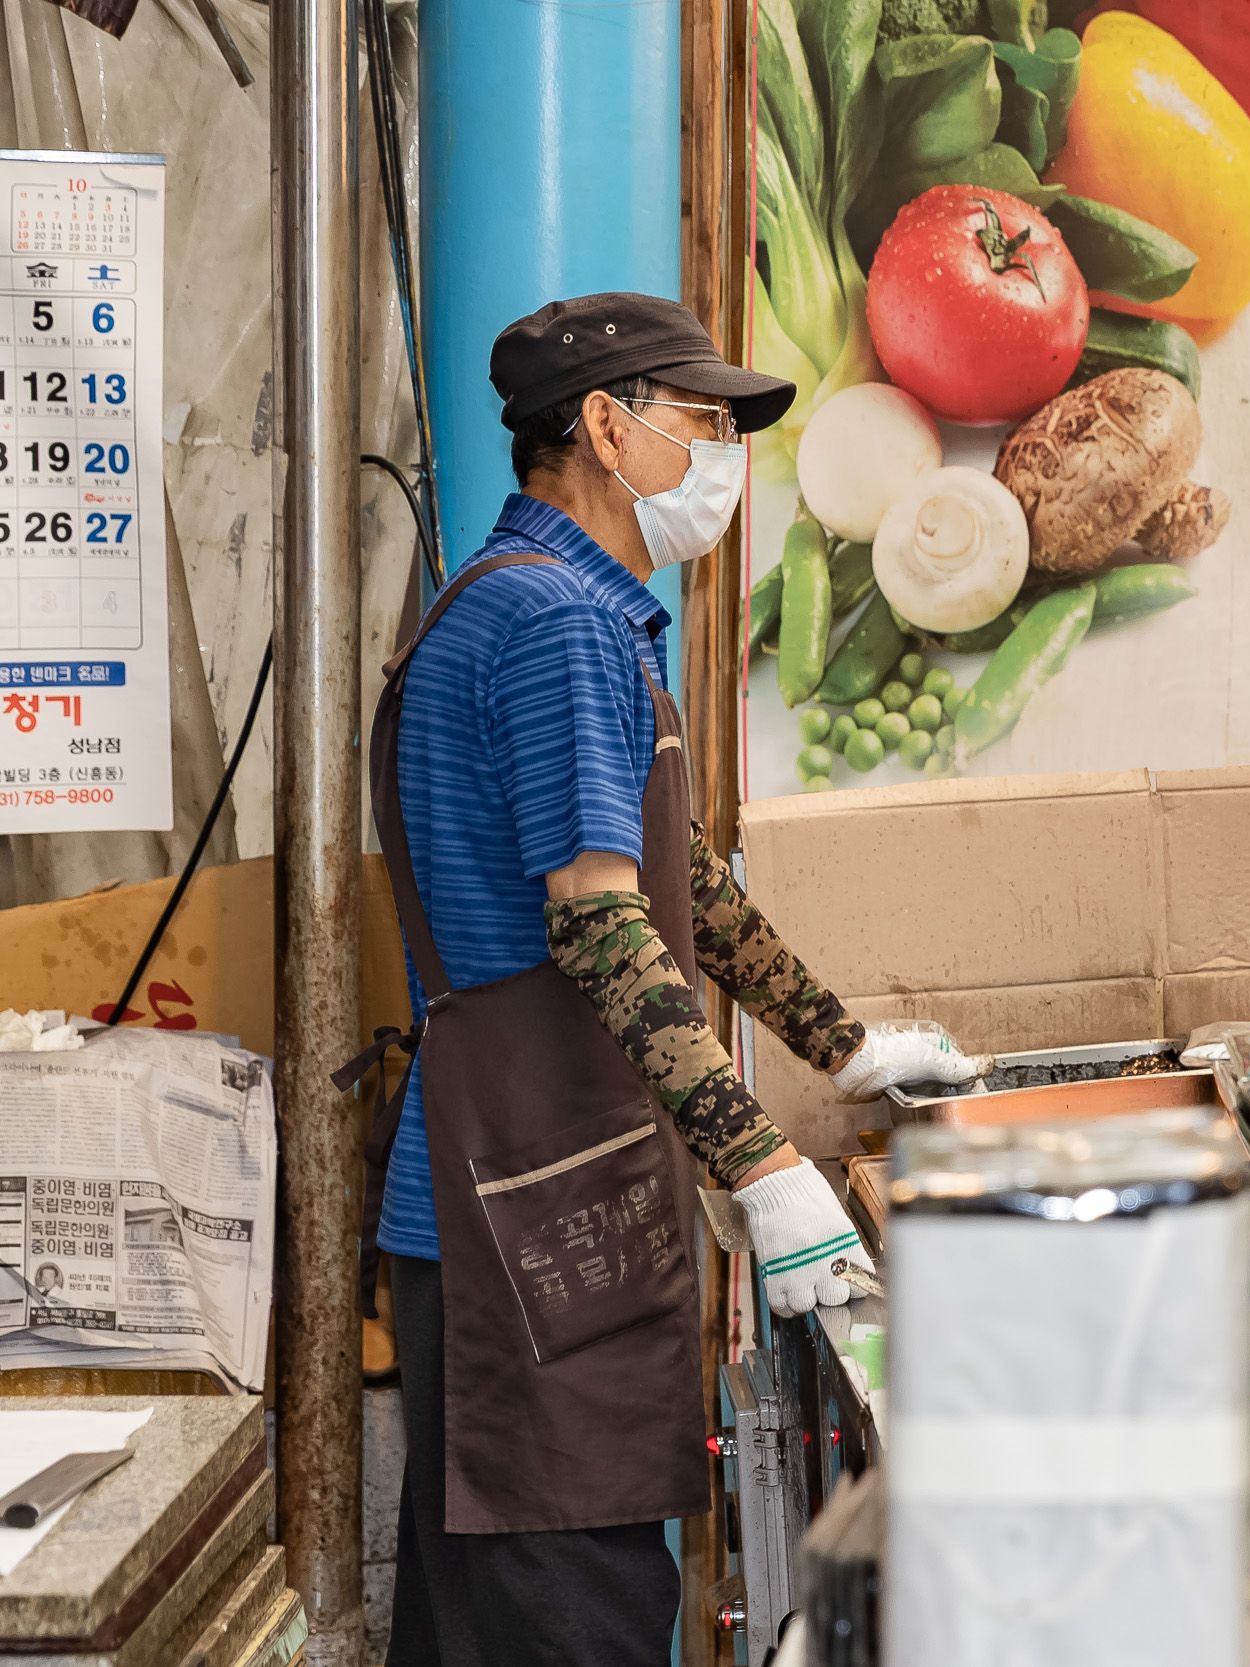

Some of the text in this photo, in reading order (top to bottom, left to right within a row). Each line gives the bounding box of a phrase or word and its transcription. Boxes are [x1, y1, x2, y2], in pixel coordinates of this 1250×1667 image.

[67, 178, 87, 192] 10
[18, 221, 131, 233] 12 13 14 15 16 17 18
[103, 214, 114, 222] 10
[120, 214, 129, 223] 11
[18, 231, 131, 244] 19 20 21 22 23 24 25
[17, 241, 112, 253] 26 27 28 29 30 31
[33, 280, 115, 290] FRI SAT
[32, 301, 115, 333] 5 6
[22, 371, 67, 402] 12
[81, 373, 127, 405] 13
[24, 442, 70, 472] 19
[84, 443, 130, 474] 20
[24, 512, 73, 544] 26
[86, 513, 132, 544] 27
[30, 665, 71, 682] 덴마크
[3, 693, 81, 733] 청기
[68, 737, 121, 755] 성남점
[0, 767, 30, 783] 빌딩
[38, 767, 60, 782] 3층
[23, 788, 114, 806] 758-9800
[32, 1197, 114, 1217] 독립문한의원
